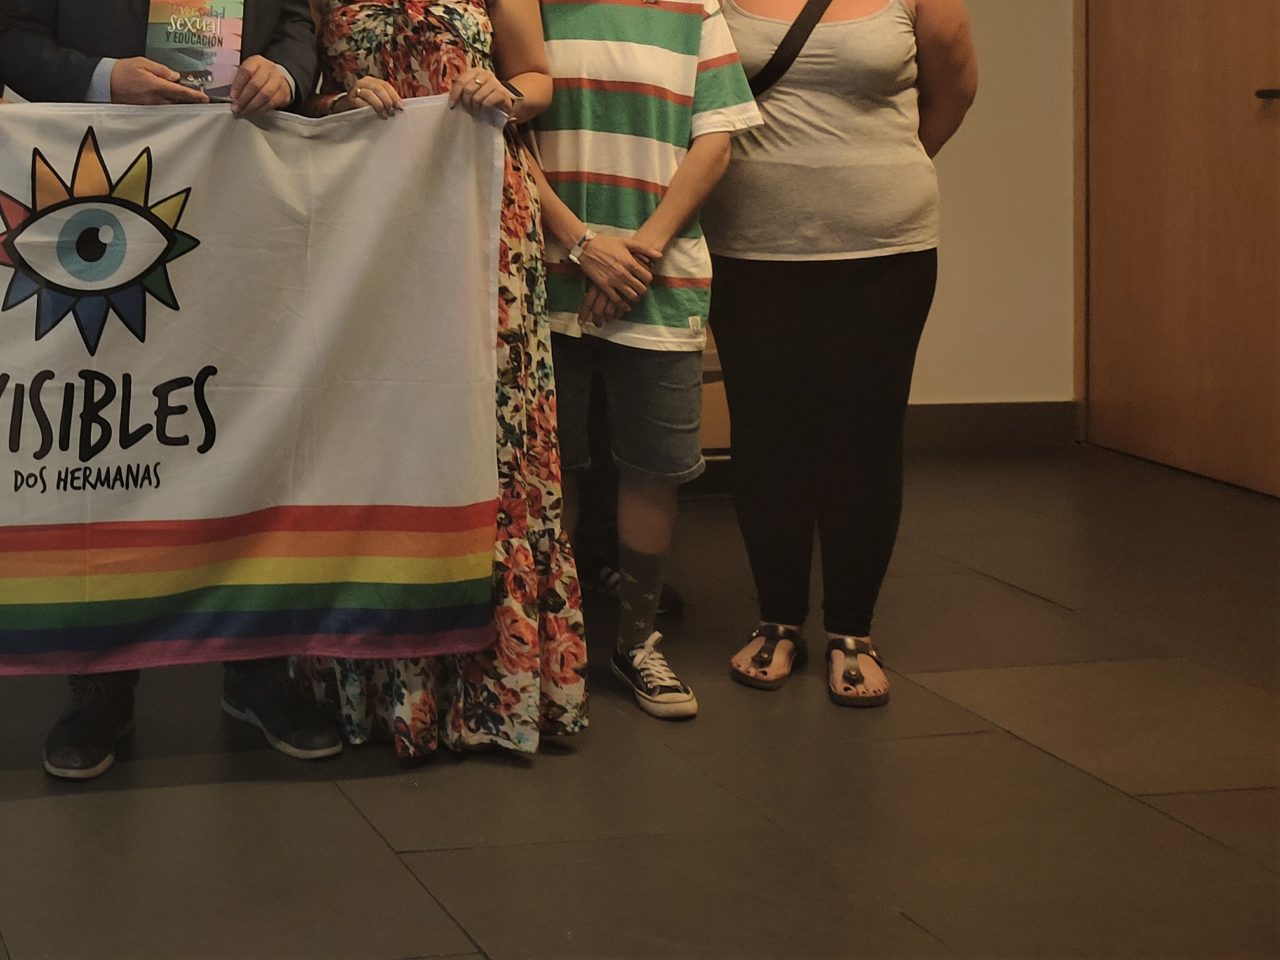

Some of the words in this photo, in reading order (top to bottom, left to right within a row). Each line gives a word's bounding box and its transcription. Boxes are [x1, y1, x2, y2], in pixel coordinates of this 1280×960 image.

[166, 31, 171, 42] Y
[173, 31, 223, 48] EDUCACIÓN
[14, 466, 47, 493] DOS
[56, 462, 161, 491] HERMANAS
